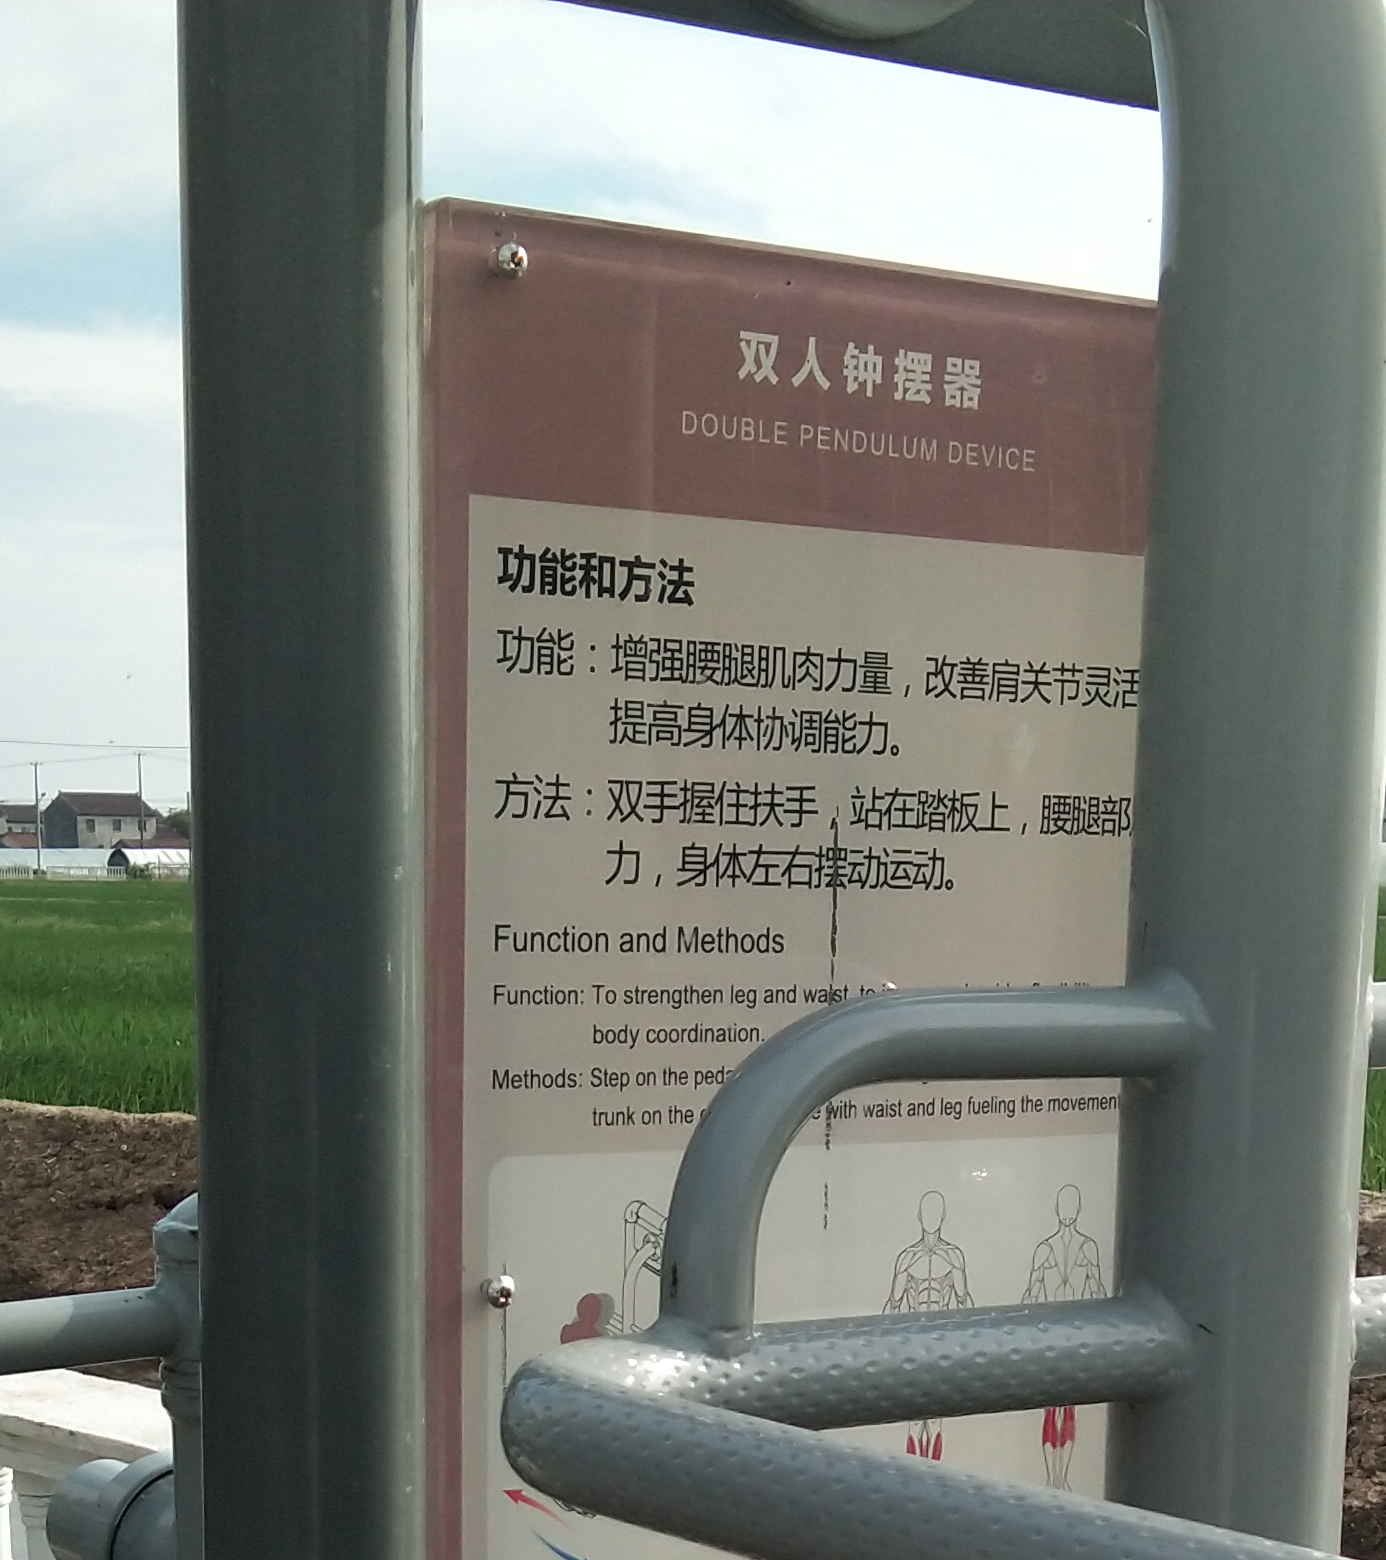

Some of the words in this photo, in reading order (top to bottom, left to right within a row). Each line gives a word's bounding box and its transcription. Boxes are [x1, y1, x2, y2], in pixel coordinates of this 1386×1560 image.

[737, 331, 982, 410] 双人钟摆器
[681, 410, 788, 446] DOUBLE
[799, 425, 938, 462] PENDULUM
[948, 441, 1036, 473] DEVICE
[496, 545, 695, 606] 功能和方法
[608, 698, 901, 757] 提高身体协调能力。
[494, 771, 1133, 837] 方法：双手握住扶手，站在踏板上，腰腿部
[604, 839, 956, 892] 力，身体左右摆动运动。
[493, 924, 610, 953] Function
[618, 925, 667, 953] and
[676, 926, 785, 954] Methods
[492, 984, 585, 1005] Function:
[592, 984, 617, 1005] To
[623, 985, 724, 1009] strengthen
[731, 985, 757, 1009] leg
[763, 984, 797, 1004] and
[593, 1024, 640, 1049] body
[645, 1023, 765, 1044] coordination.
[491, 1068, 583, 1090] Methods:
[590, 1067, 630, 1091] Step
[636, 1069, 657, 1087] on
[662, 1067, 689, 1086] the
[592, 1107, 636, 1126] trunk
[641, 1108, 662, 1125] on
[668, 1106, 694, 1125] the
[863, 1099, 903, 1118] waist
[906, 1097, 935, 1116] and
[940, 1097, 963, 1120] leg
[967, 1096, 1015, 1119] fueling
[1020, 1095, 1044, 1114] the
